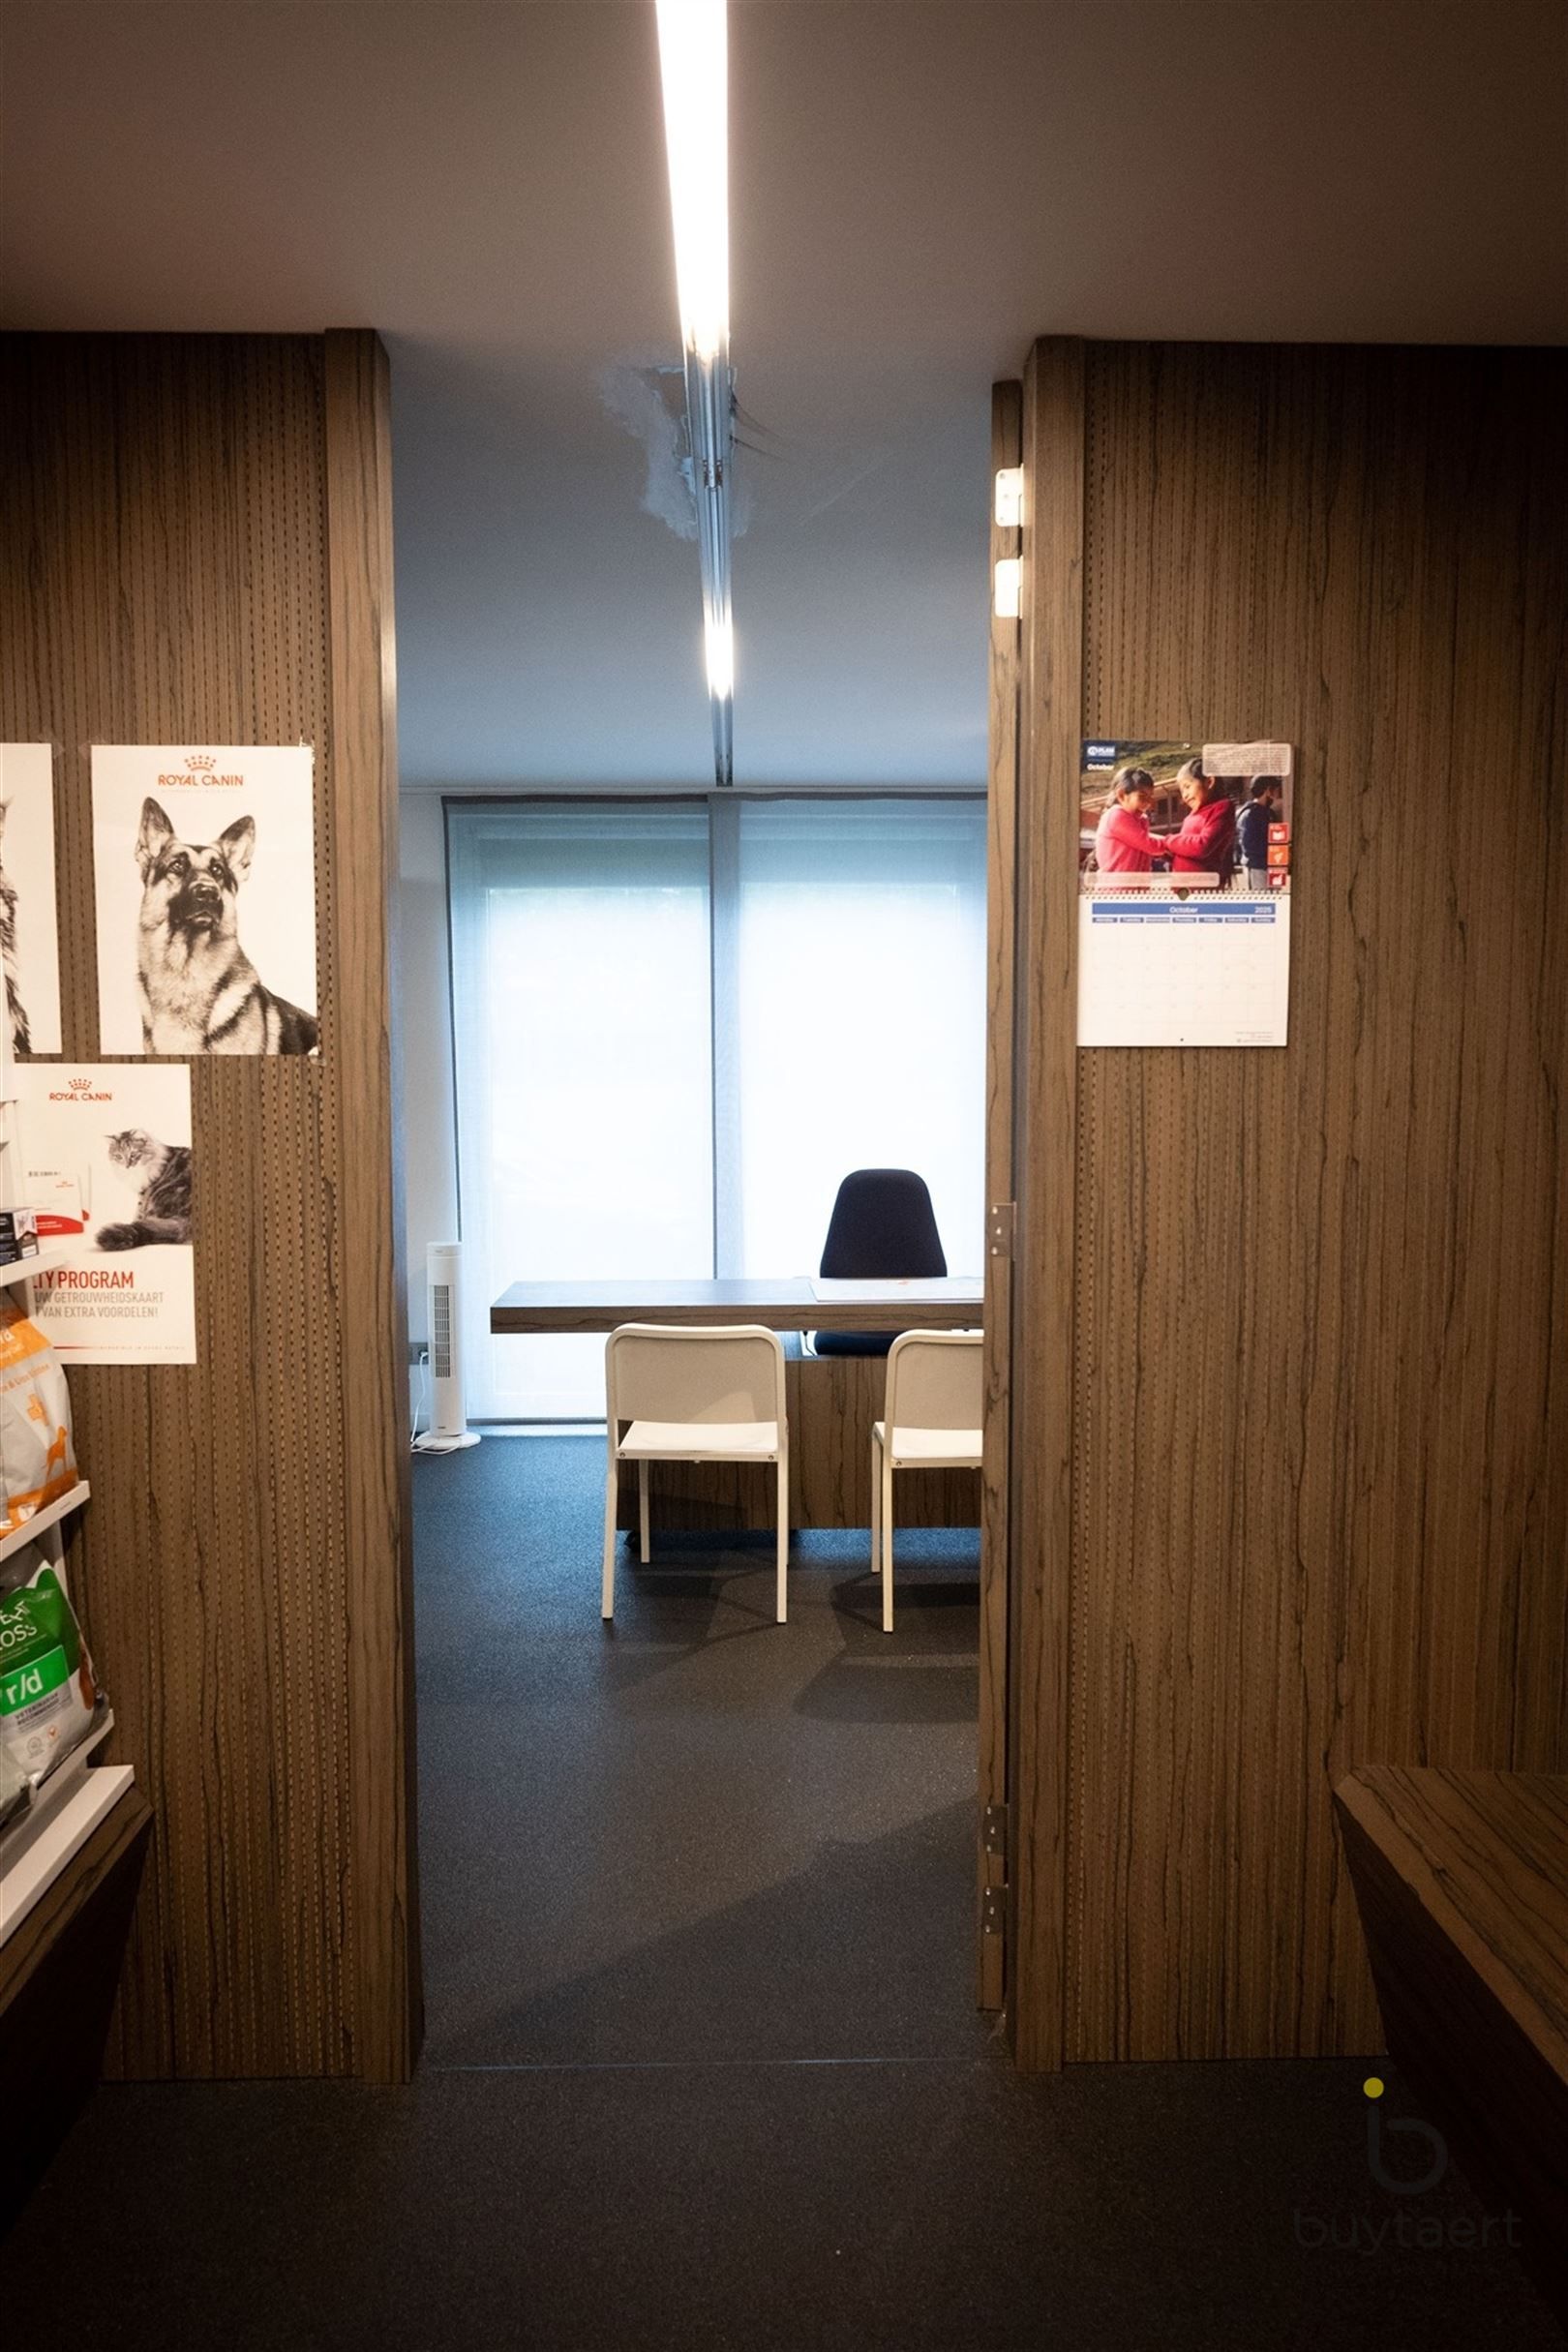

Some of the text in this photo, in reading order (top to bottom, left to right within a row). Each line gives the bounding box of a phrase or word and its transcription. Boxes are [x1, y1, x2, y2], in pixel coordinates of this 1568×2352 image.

[158, 774, 244, 786] ROYAL CANIN
[49, 1092, 112, 1101] ROYAL CANIN
[58, 1271, 134, 1288] PROGRAM
[54, 1291, 164, 1304] GETROUWHEIDSKAART
[43, 1306, 61, 1317] VAN
[64, 1306, 95, 1317] EXTRA
[97, 1306, 159, 1317] VOORDELEN!
[6, 1668, 43, 1705] r/d
